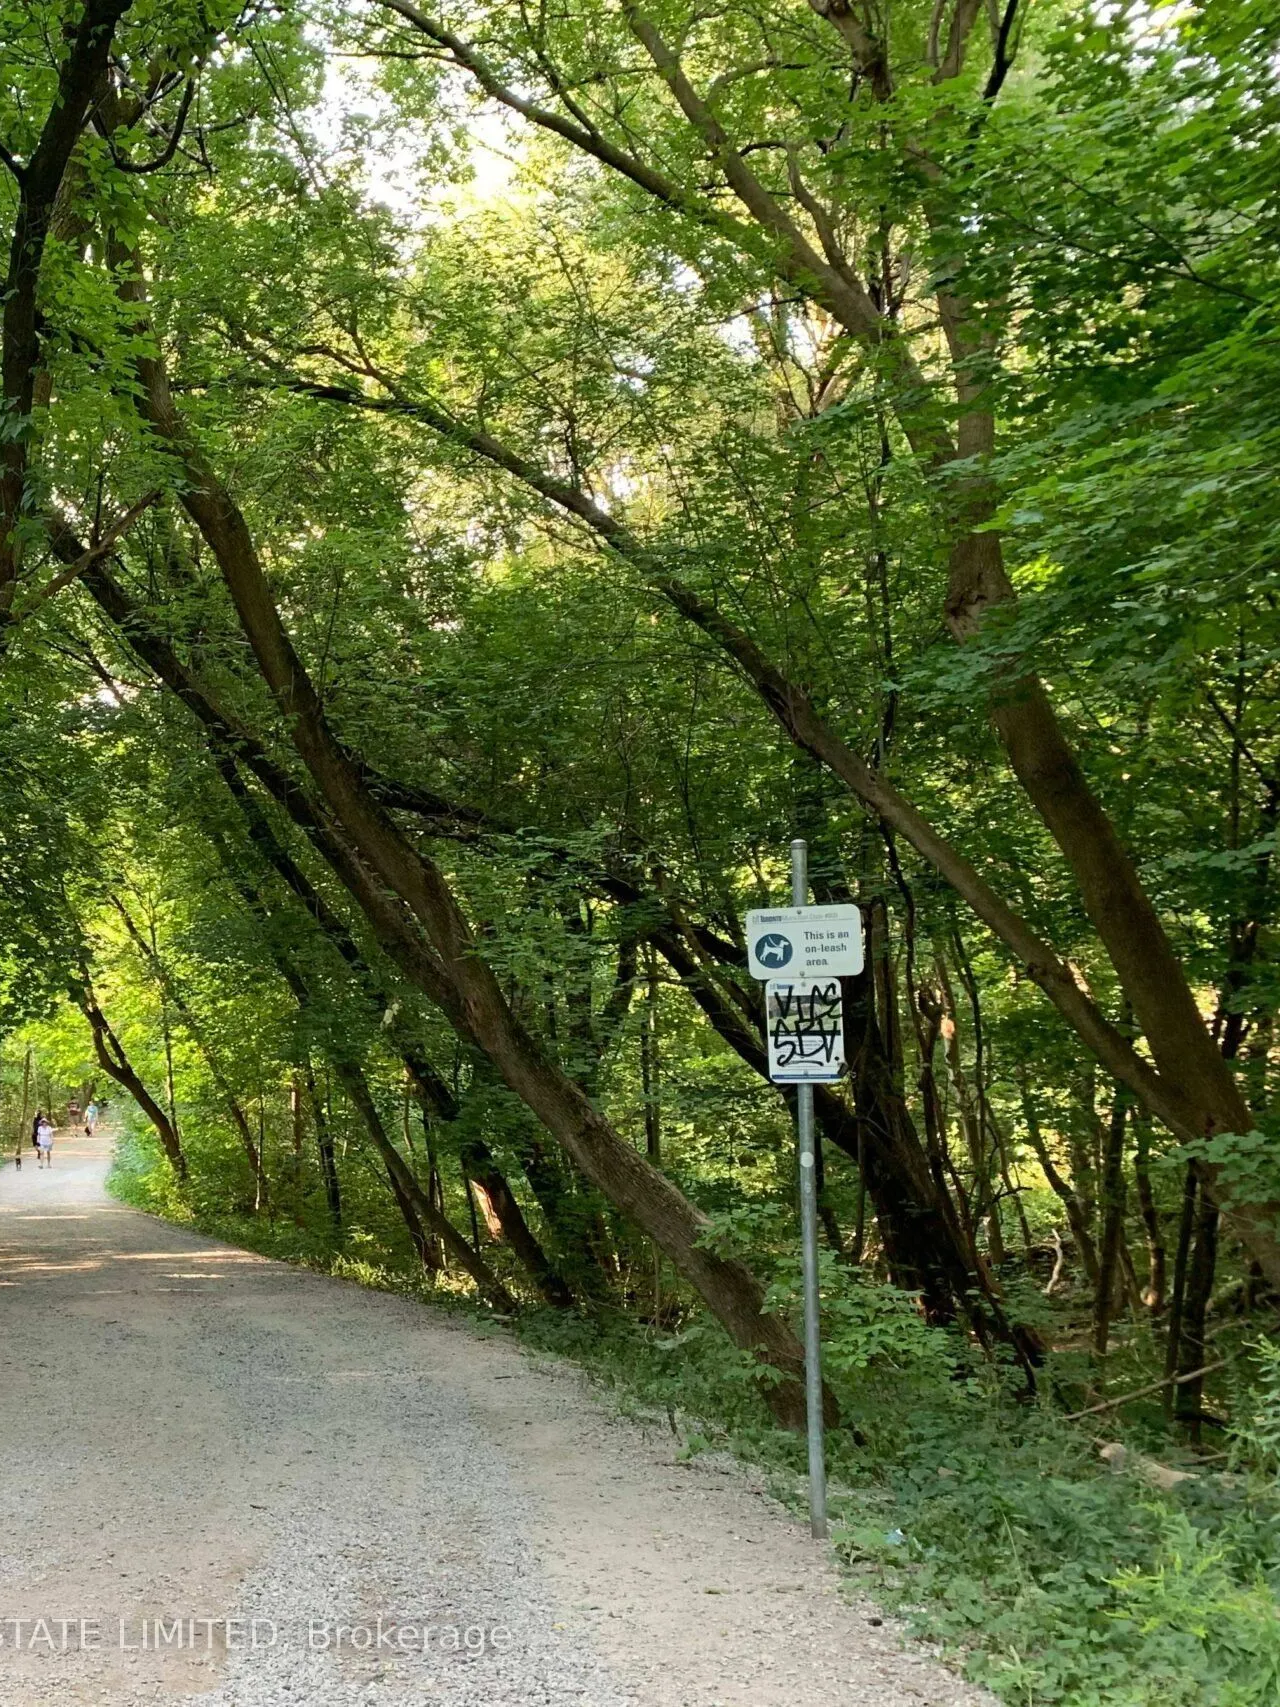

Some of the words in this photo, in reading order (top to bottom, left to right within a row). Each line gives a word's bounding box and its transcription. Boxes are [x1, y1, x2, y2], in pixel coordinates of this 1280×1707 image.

[804, 931, 825, 940] This
[826, 930, 835, 939] is
[805, 942, 848, 953] on-leash
